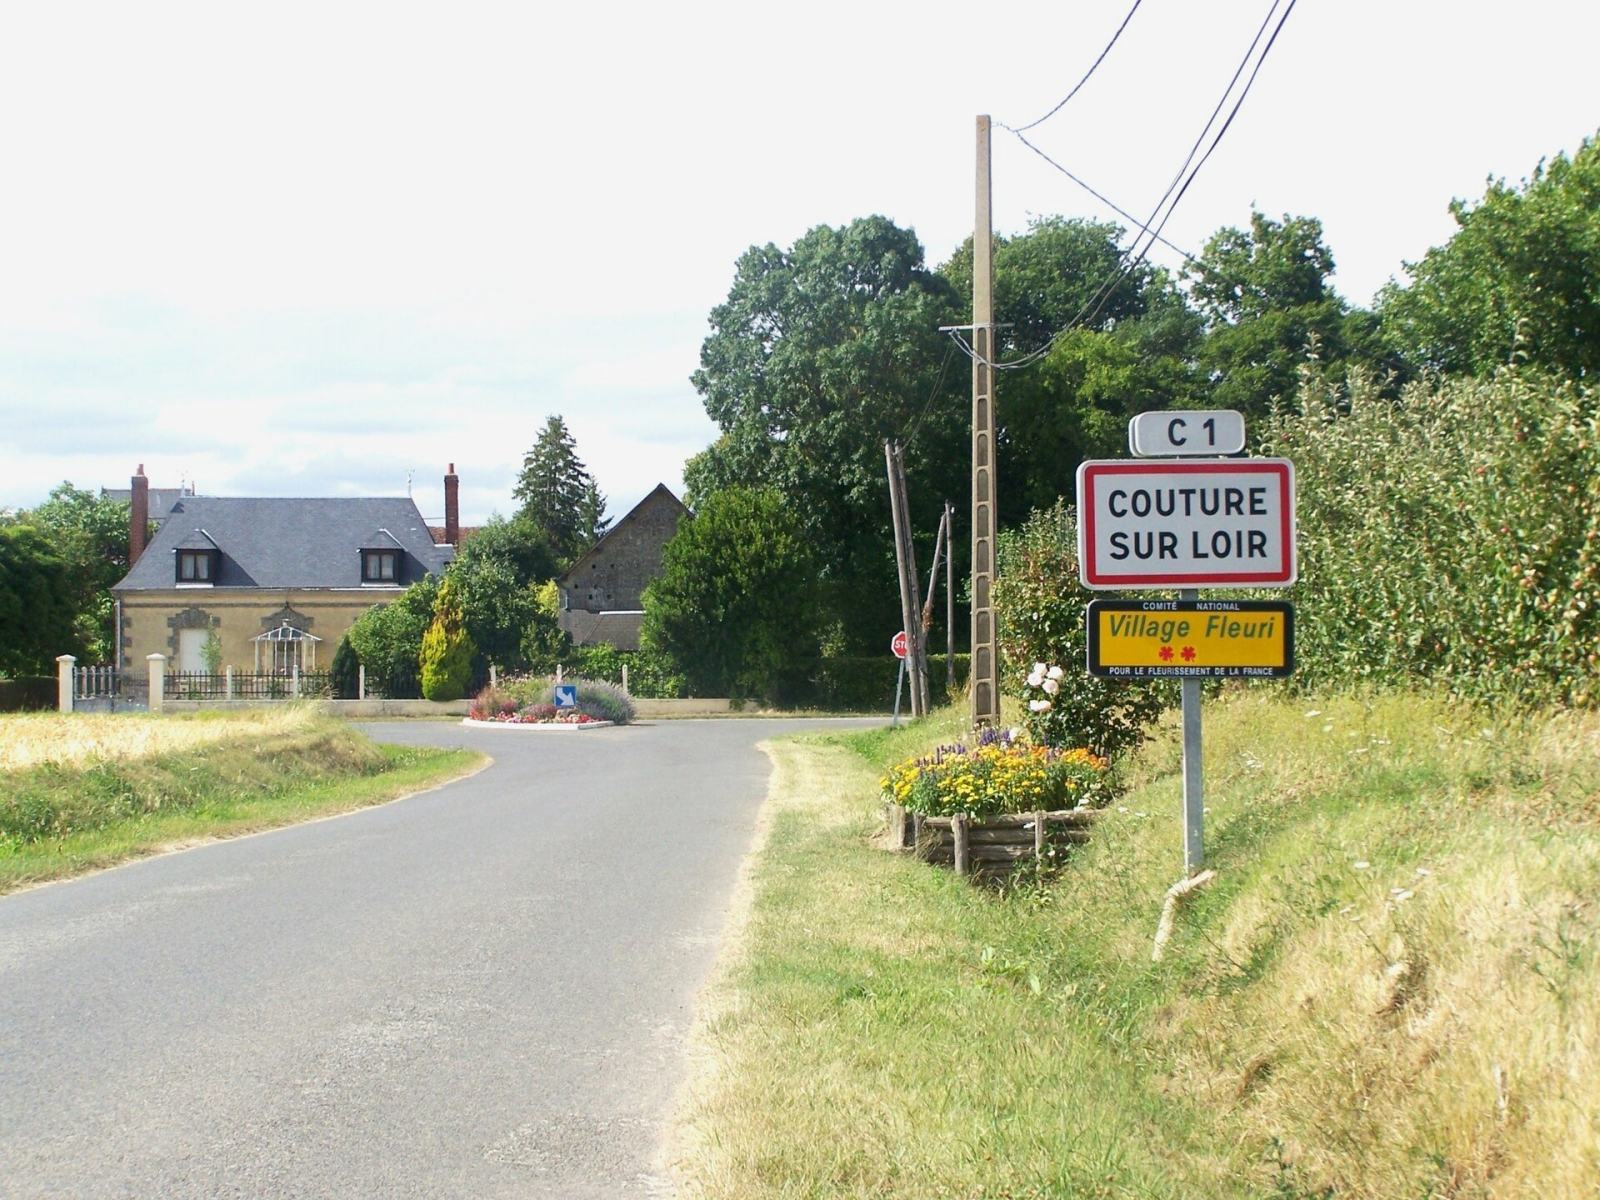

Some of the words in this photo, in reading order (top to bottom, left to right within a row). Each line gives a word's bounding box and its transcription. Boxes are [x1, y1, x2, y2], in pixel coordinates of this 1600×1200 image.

[1167, 418, 1187, 446] C
[1203, 418, 1216, 446] 1
[1108, 487, 1268, 518] COUTURE
[1109, 531, 1178, 560] SUR
[1192, 530, 1268, 559] LOIR
[1196, 602, 1240, 611] NATIONAL
[1109, 614, 1190, 643] Village
[1205, 615, 1275, 638] Fleuri
[1109, 667, 1130, 675] POUR
[1134, 667, 1144, 675] LE
[1148, 667, 1210, 676] FLEURISSEMENT
[1214, 667, 1225, 676] DE
[1229, 667, 1239, 676] LA
[1243, 667, 1273, 676] FRANCE
